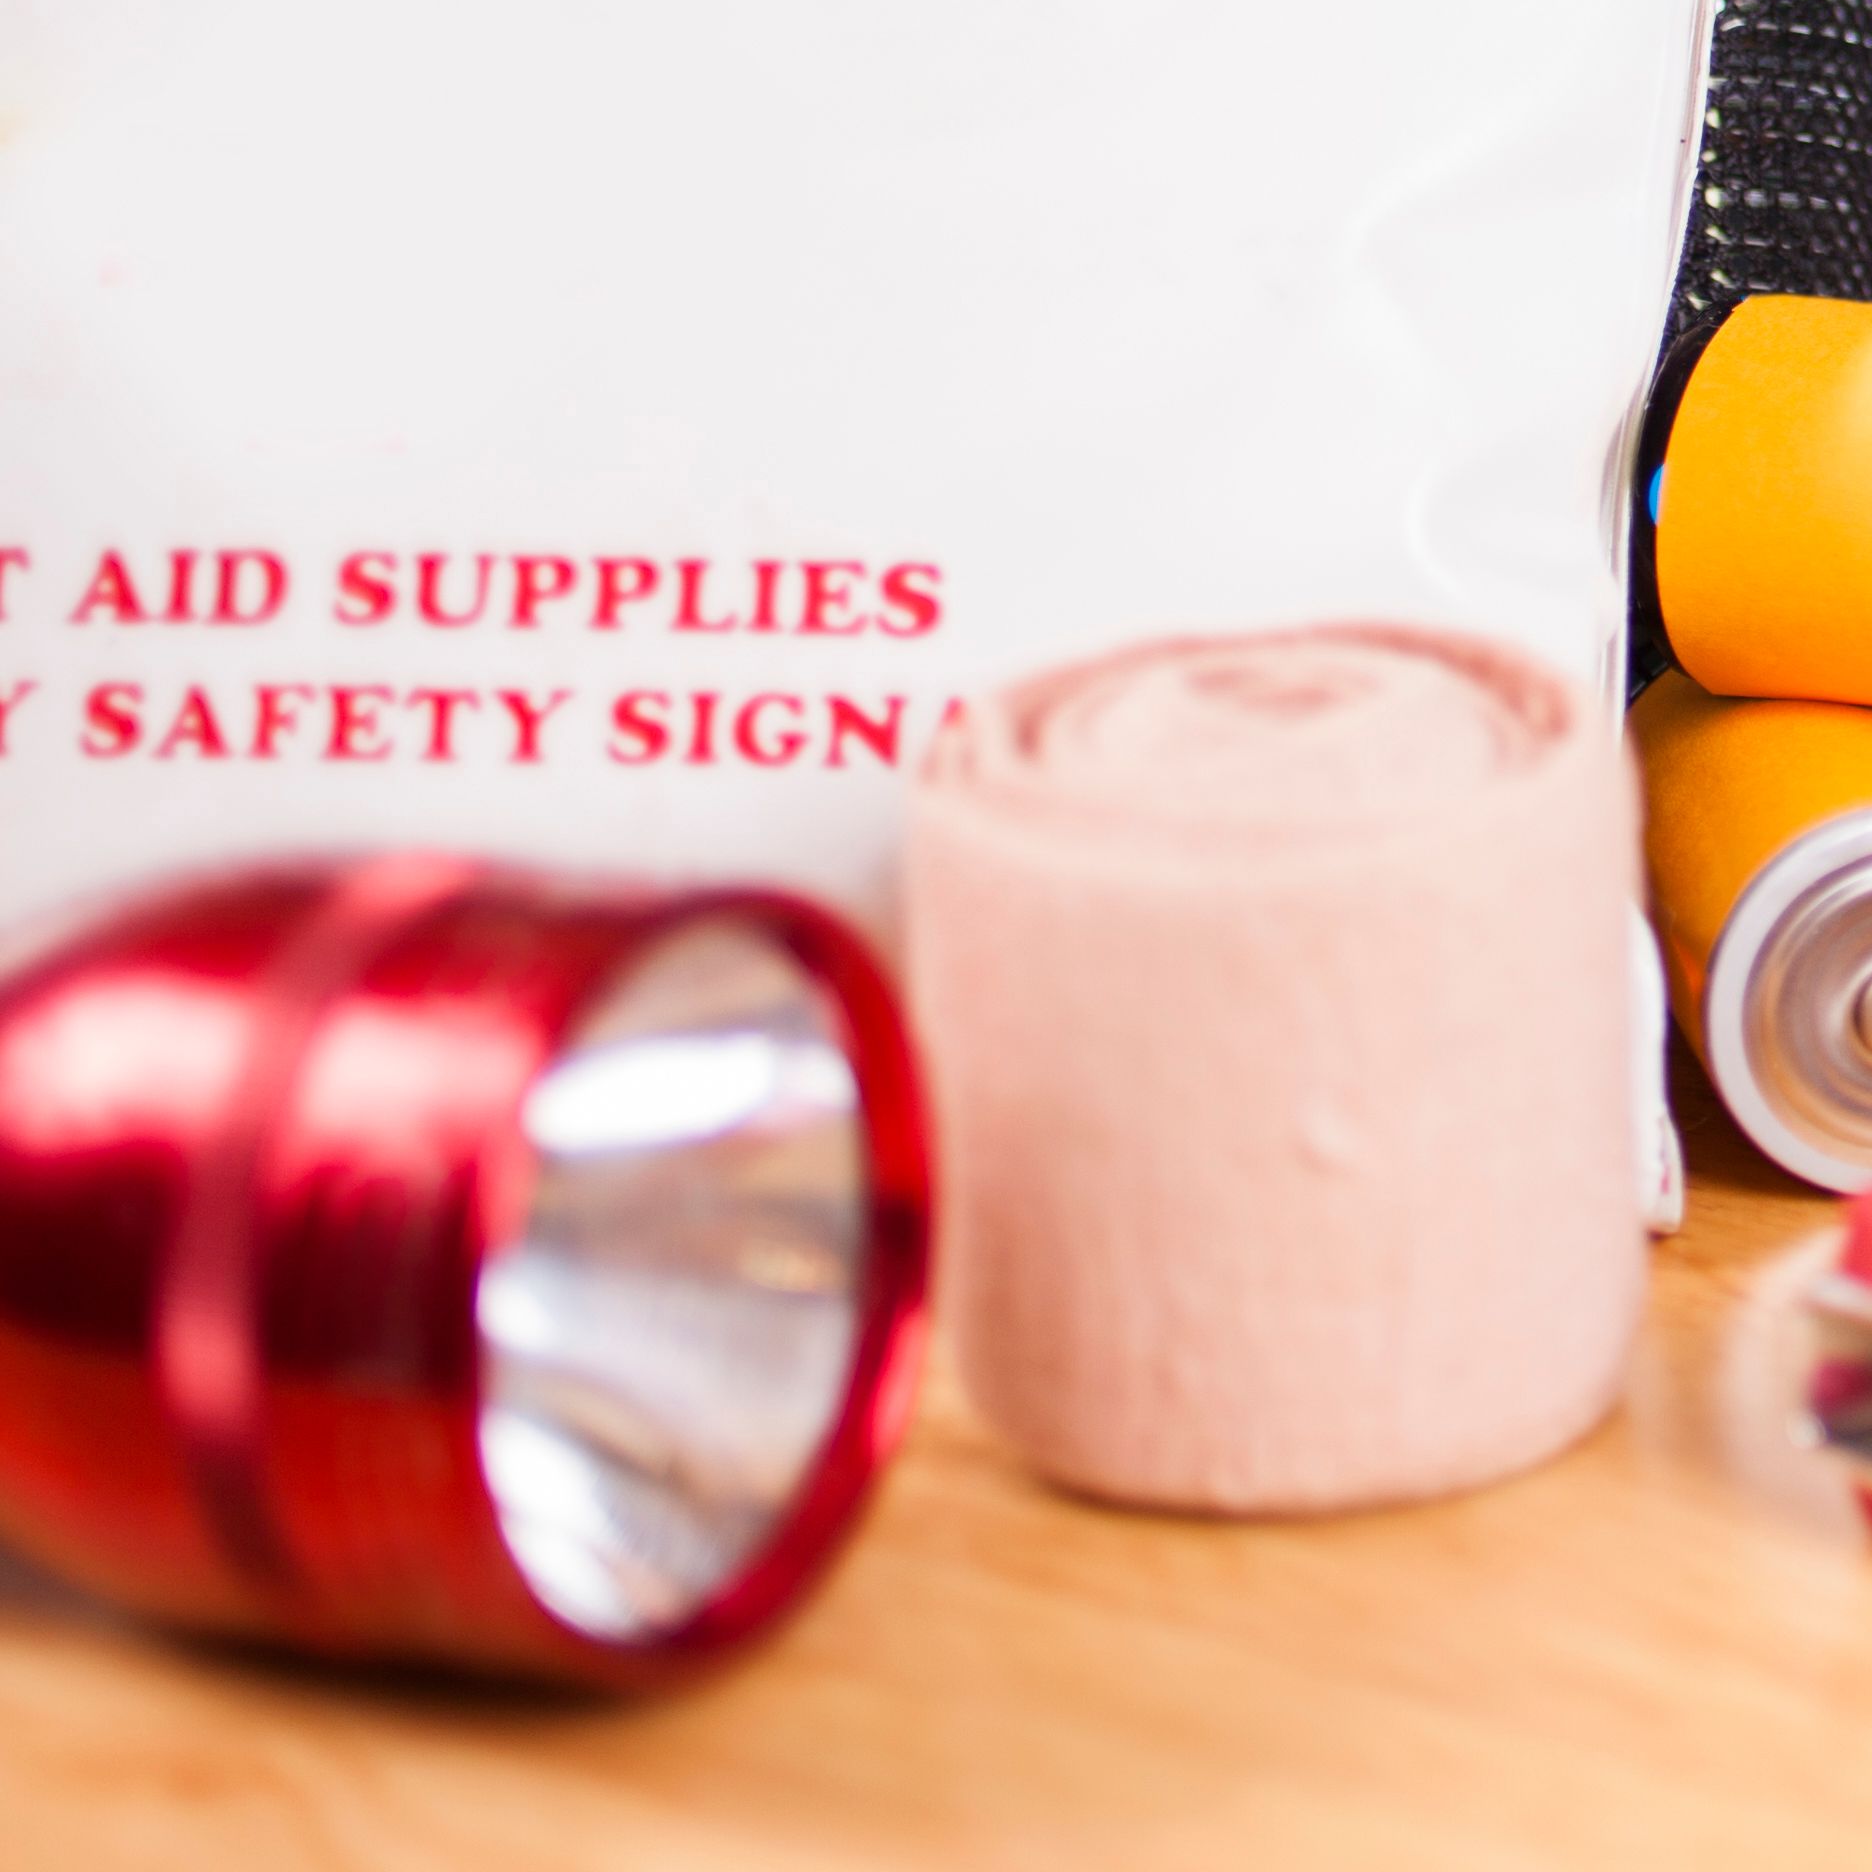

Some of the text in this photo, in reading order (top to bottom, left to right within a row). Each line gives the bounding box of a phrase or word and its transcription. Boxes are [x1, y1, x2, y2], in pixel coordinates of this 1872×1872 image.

[68, 544, 294, 628] AID
[331, 548, 946, 642] SUPPLIES
[77, 678, 574, 768] SAFETY
